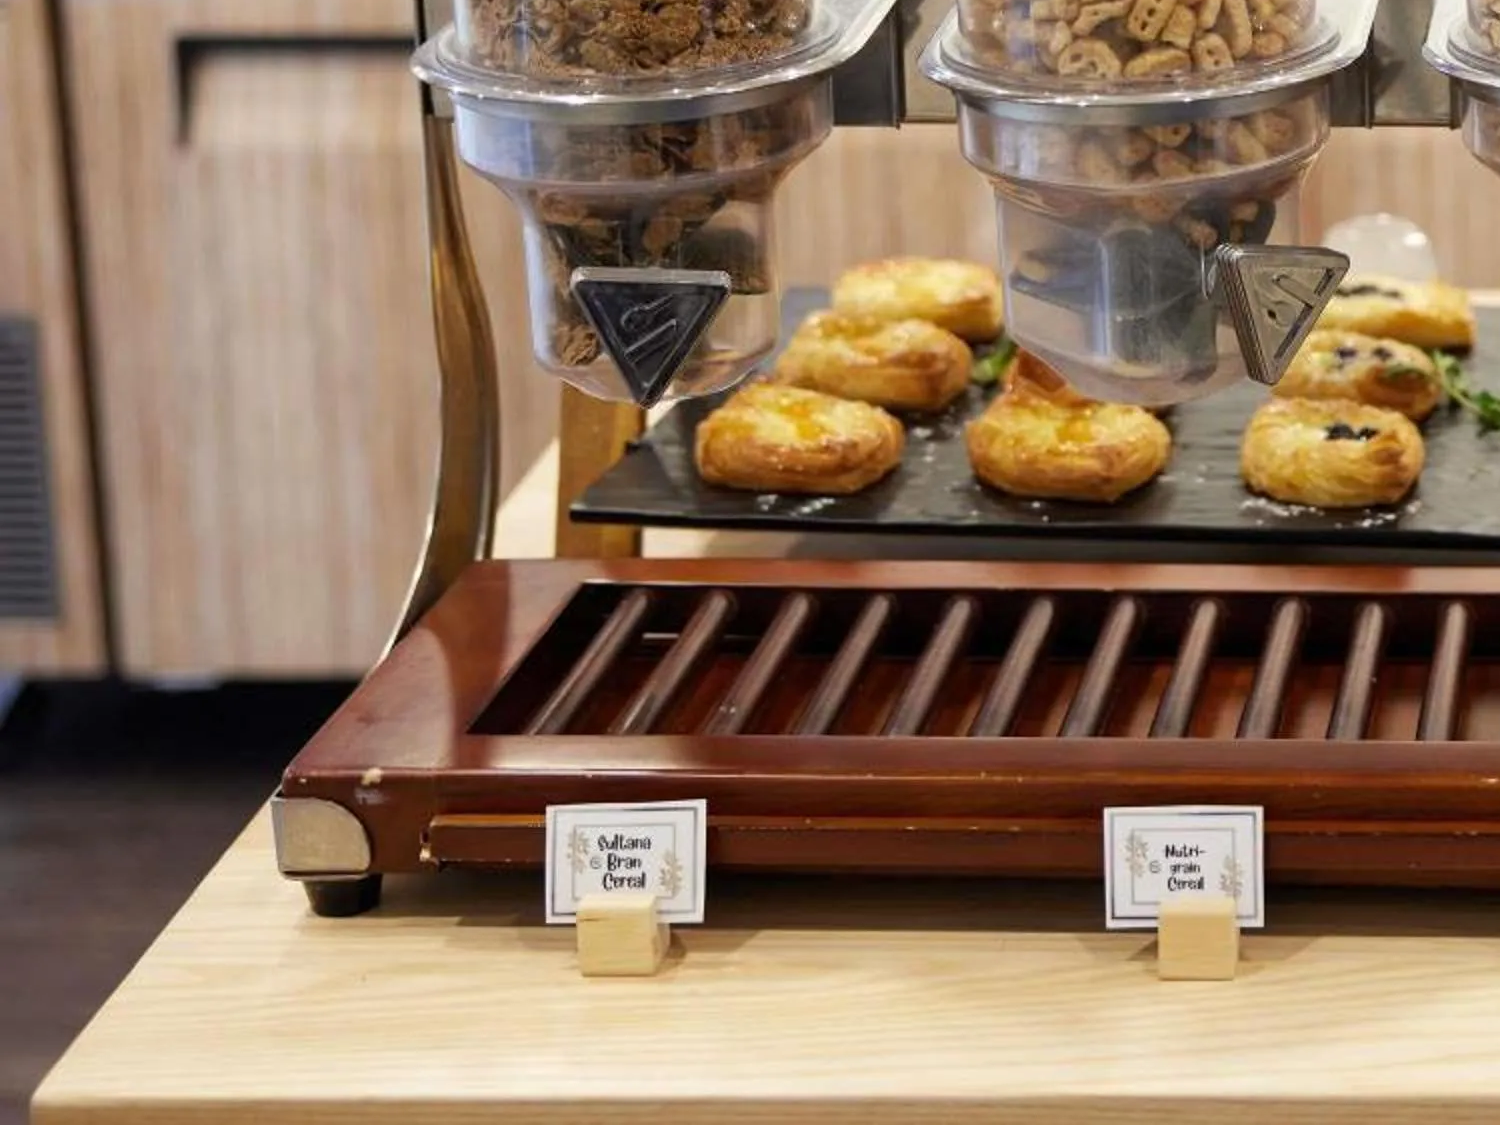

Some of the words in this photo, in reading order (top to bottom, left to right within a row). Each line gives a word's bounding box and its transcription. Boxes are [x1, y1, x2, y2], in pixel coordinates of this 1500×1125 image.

[597, 833, 652, 852] Sultana
[1165, 843, 1207, 859] Nutri-
[607, 852, 642, 871] Bran
[1169, 862, 1201, 875] grain
[602, 871, 647, 891] Cereal
[1167, 876, 1205, 891] Cereal
